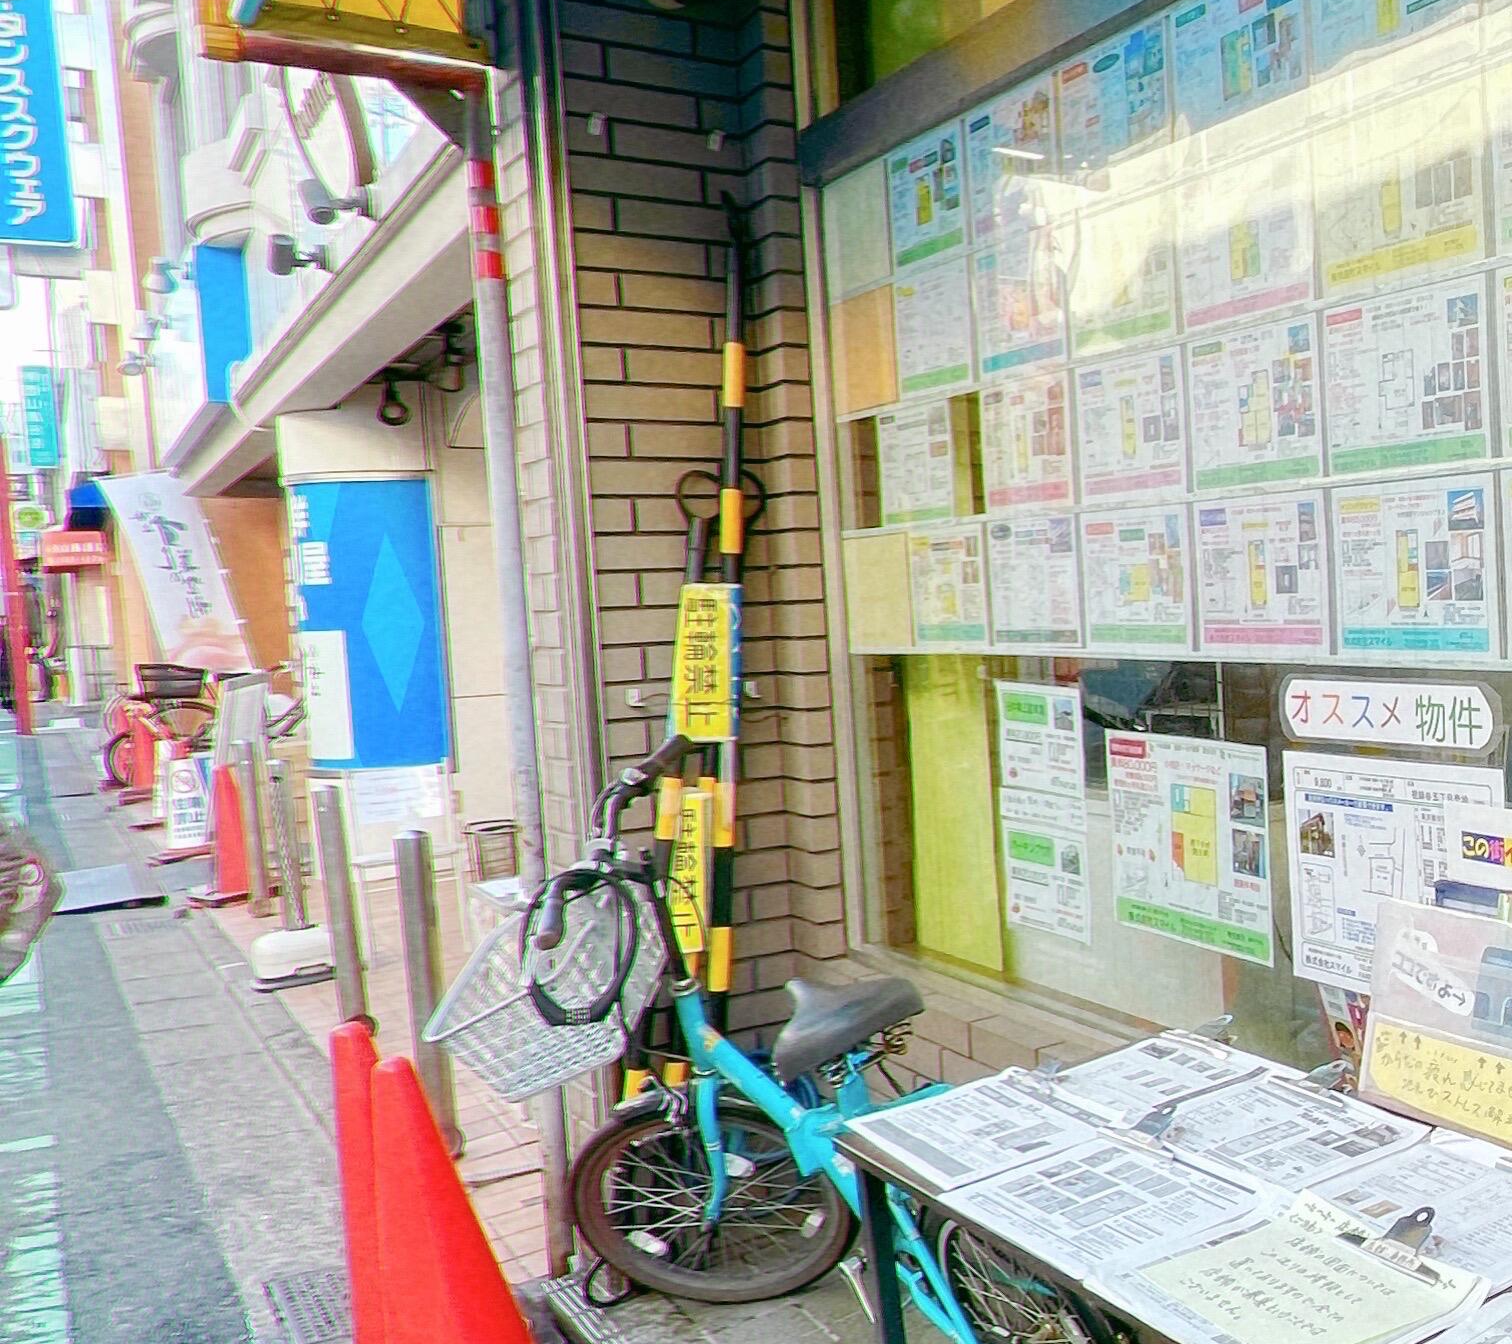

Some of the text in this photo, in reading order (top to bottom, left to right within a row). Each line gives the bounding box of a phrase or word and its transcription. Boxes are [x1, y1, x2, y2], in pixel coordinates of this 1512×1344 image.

[683, 597, 719, 729] 駐輪禁止
[1291, 690, 1484, 745] オススメ物件
